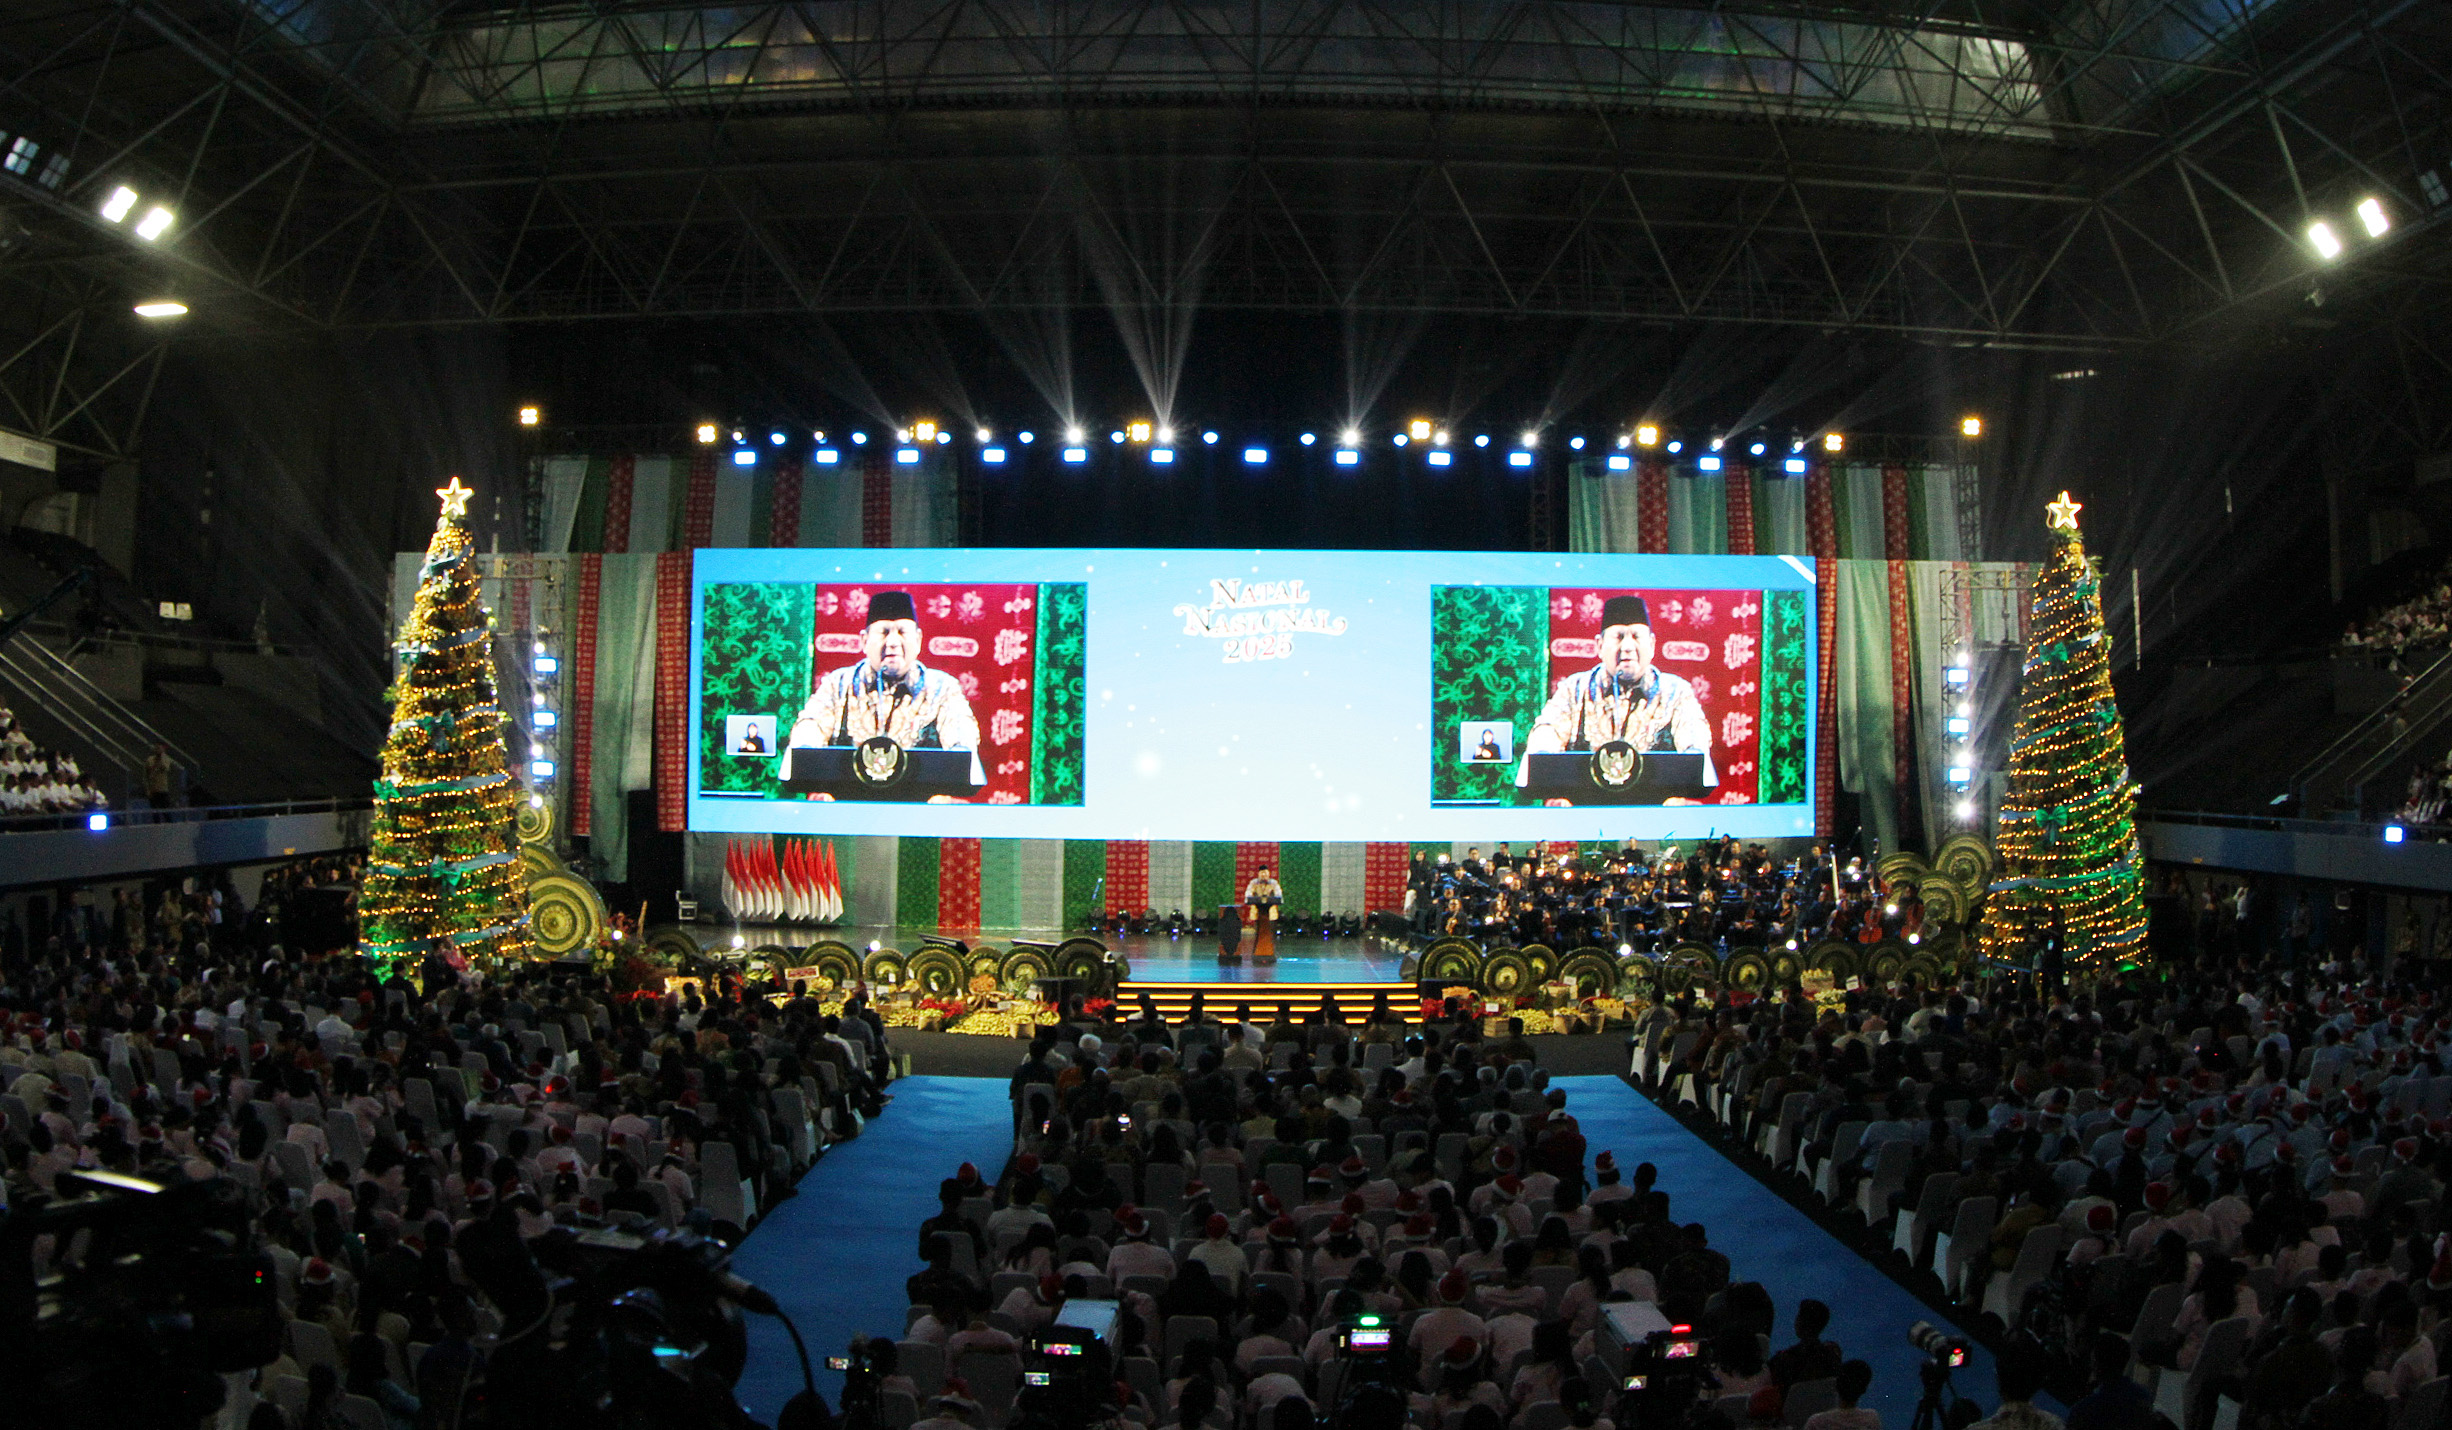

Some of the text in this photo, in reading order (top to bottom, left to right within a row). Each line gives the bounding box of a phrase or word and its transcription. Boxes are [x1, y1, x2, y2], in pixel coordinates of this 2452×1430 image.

[1211, 579, 1309, 608] NATAL
[1174, 604, 1347, 637] NASIONAL
[1223, 634, 1294, 662] 2025
